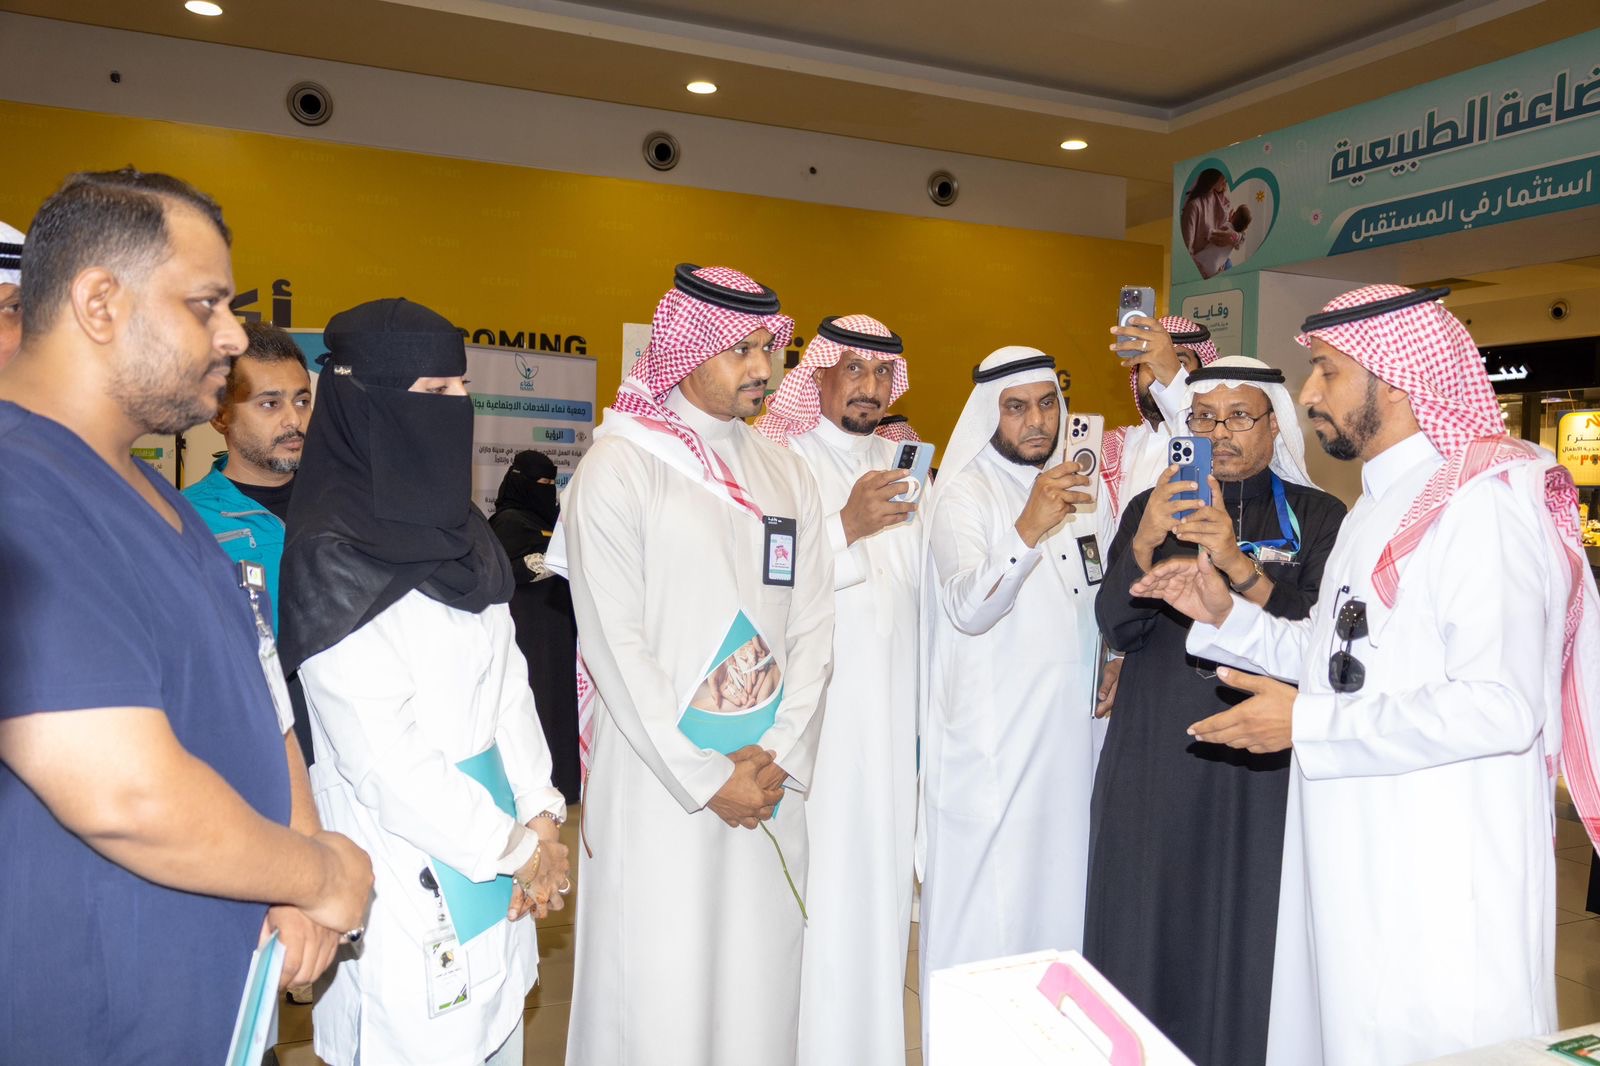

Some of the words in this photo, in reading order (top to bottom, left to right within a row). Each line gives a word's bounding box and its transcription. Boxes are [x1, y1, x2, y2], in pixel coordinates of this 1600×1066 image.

[1330, 95, 1490, 184] الطبيعية
[1460, 191, 1492, 230] في
[1351, 200, 1454, 244] المستقبل
[1193, 303, 1229, 320] وقاية
[472, 399, 485, 408] بجا
[486, 401, 521, 411] الاجتماعية
[522, 404, 550, 413] للخدمات
[551, 405, 565, 413] نماء
[567, 406, 586, 416] جمعية
[545, 430, 564, 441] الرؤية
